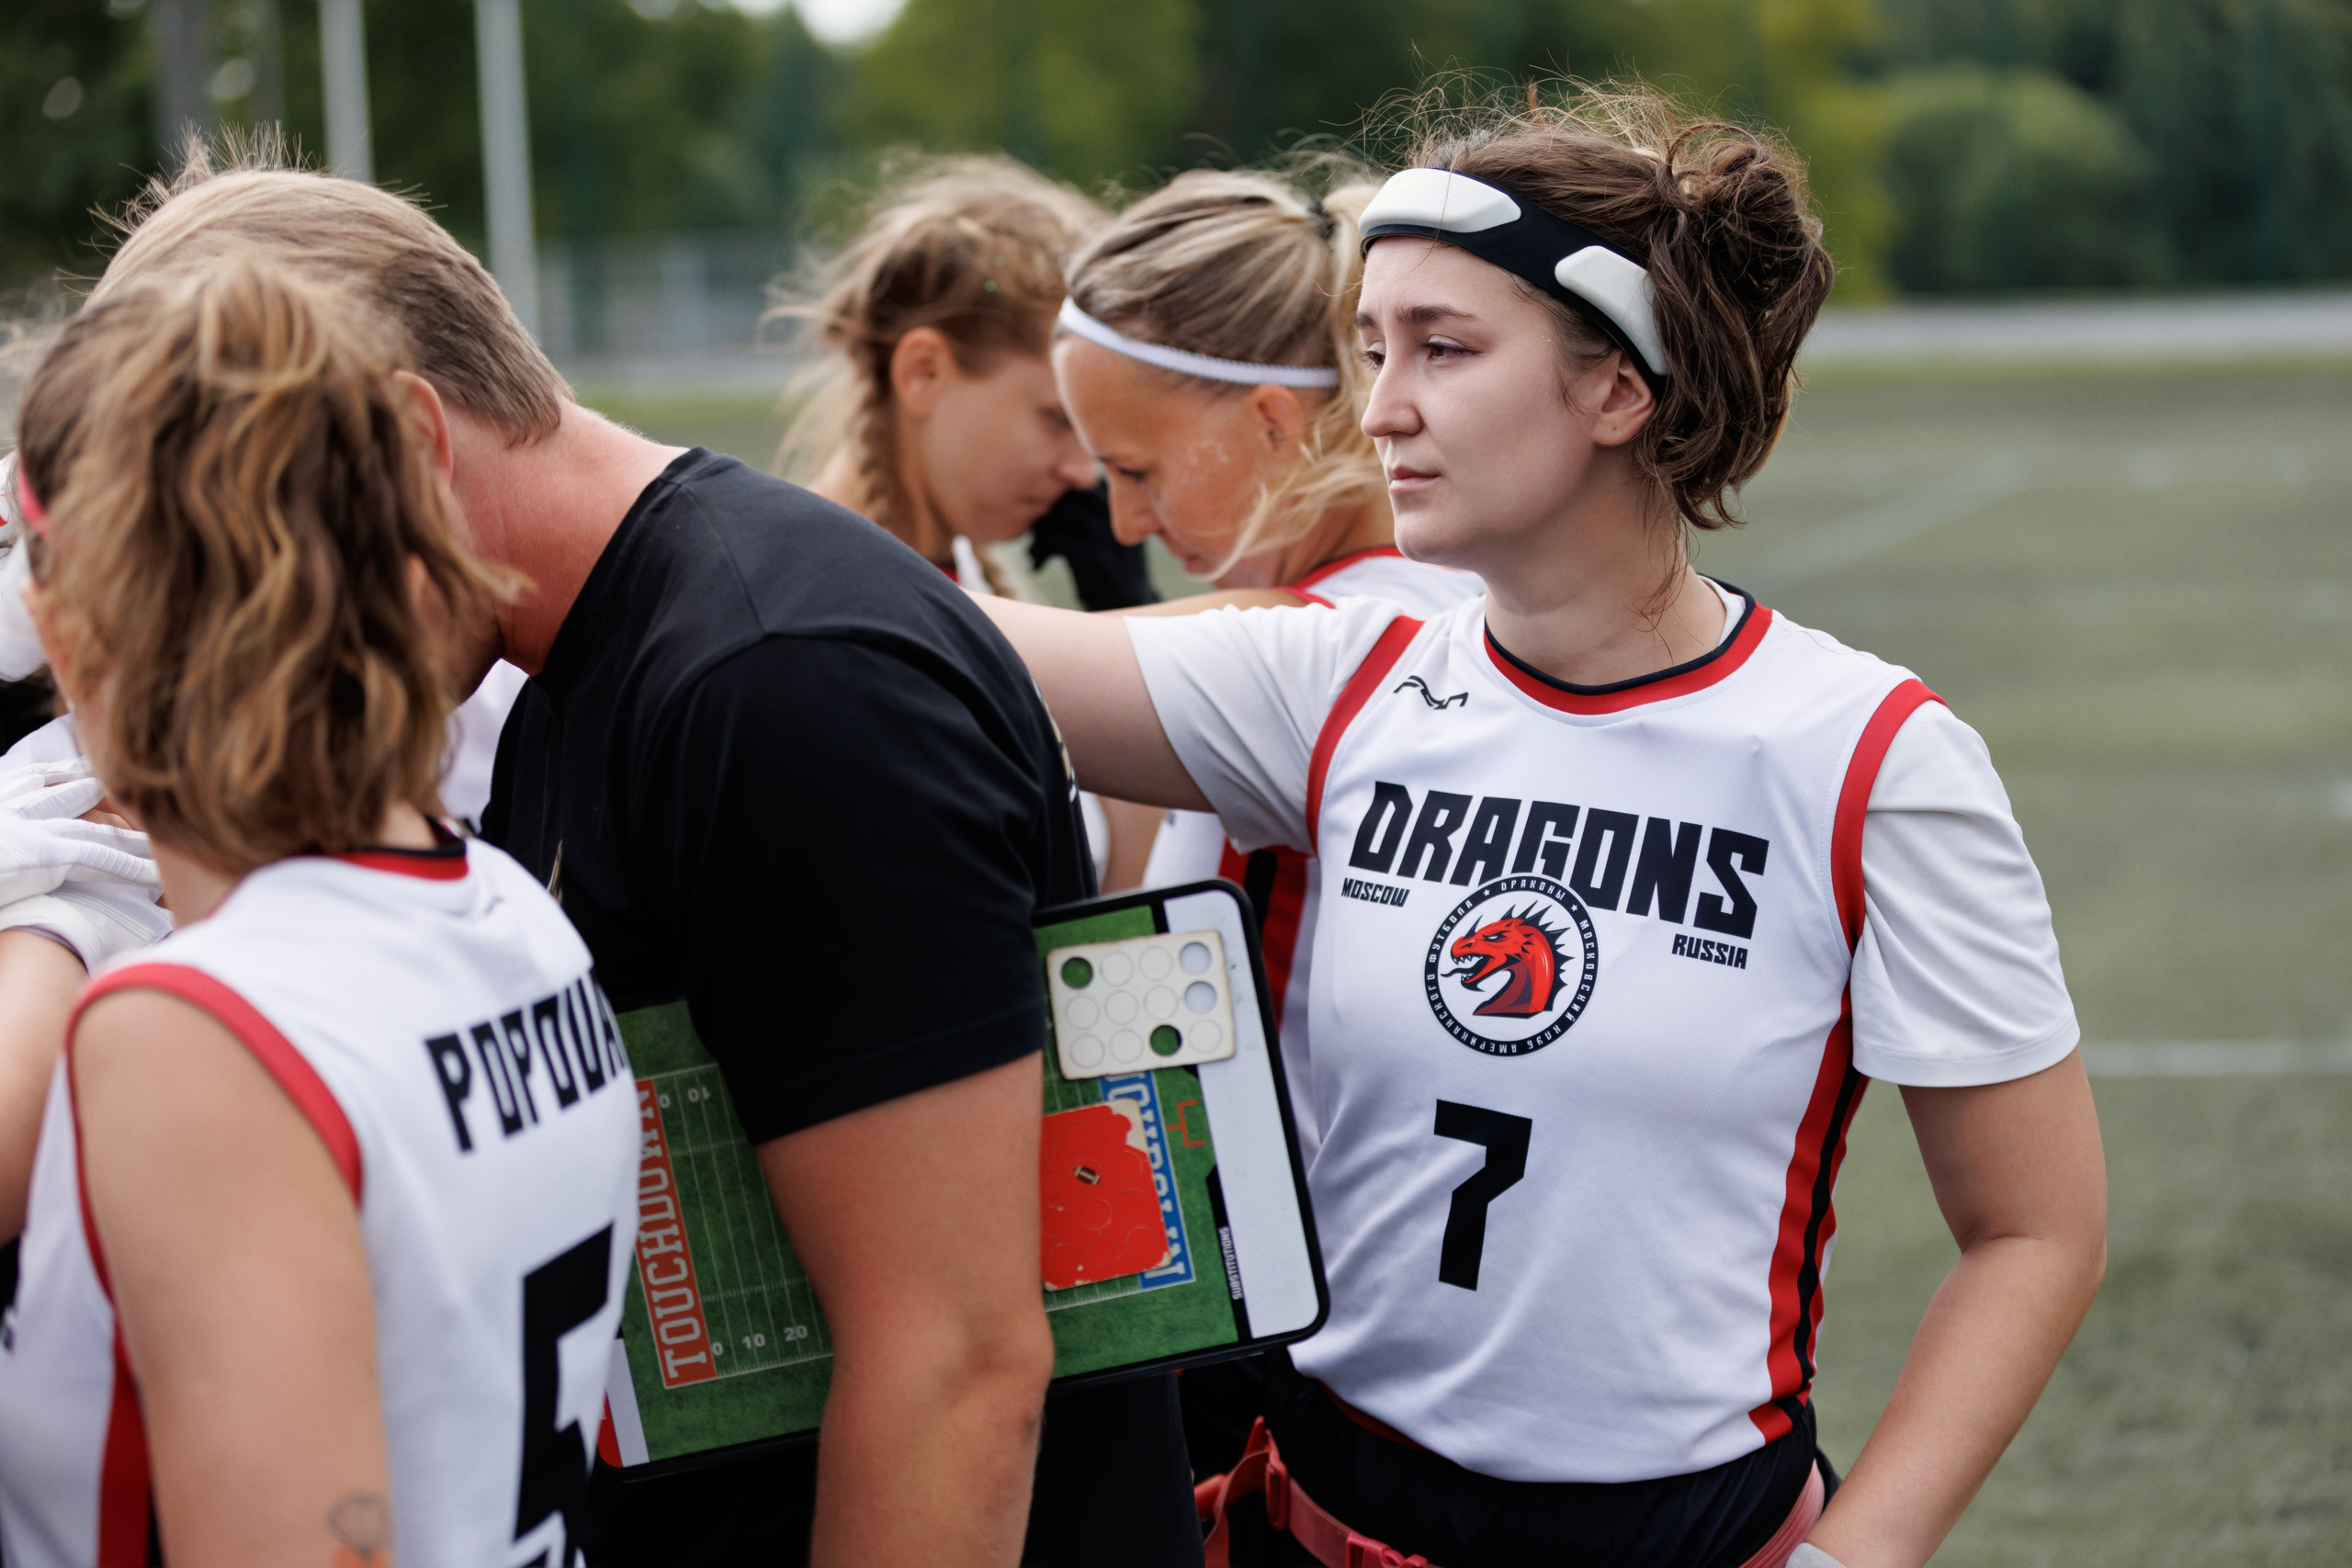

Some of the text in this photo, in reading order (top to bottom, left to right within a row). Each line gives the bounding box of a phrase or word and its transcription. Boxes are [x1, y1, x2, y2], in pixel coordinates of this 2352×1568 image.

[1348, 781, 1770, 940] DRAGONS
[1341, 877, 1410, 908] MOSCOW
[1501, 879, 1566, 901] ДРАКОНЫ
[1427, 899, 1596, 1054] МОСКОВСКИЙ КЛУБ АМЕРИКАНСКОГО ФУТБОЛА
[1671, 933, 1748, 970] RUSSIA
[1433, 1099, 1533, 1292] 7
[1217, 1225, 1243, 1301] SUBSTITUTIONS
[742, 1332, 766, 1351] 10
[784, 1325, 809, 1344] 20
